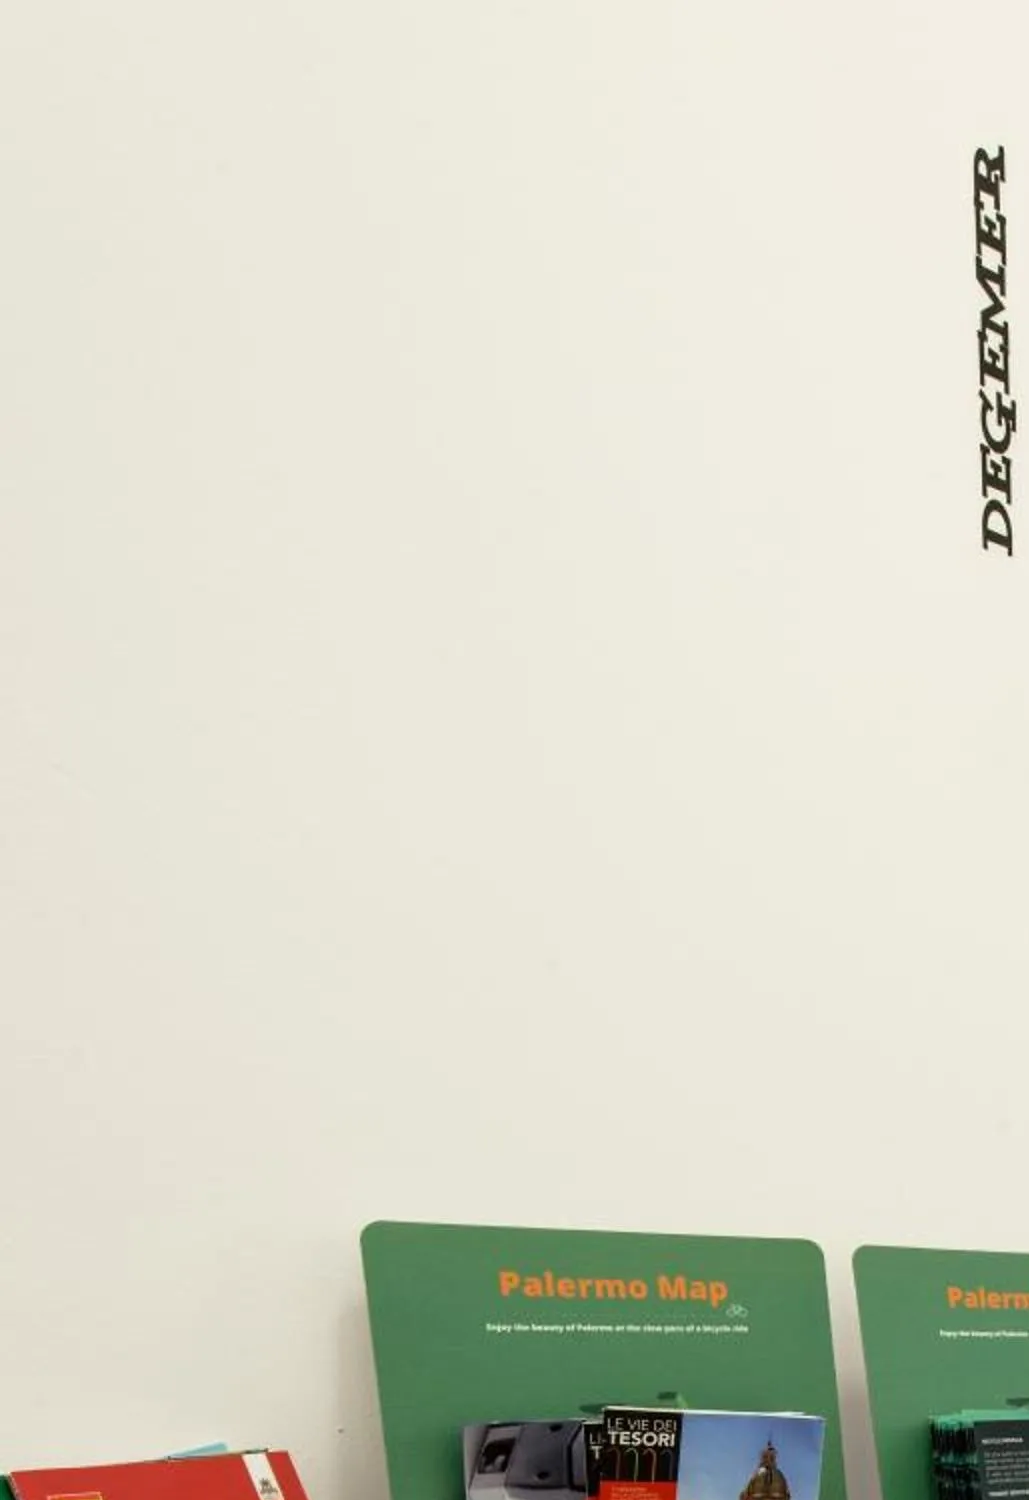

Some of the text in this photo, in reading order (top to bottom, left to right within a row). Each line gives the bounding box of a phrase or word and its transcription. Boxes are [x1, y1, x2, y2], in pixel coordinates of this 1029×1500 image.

[973, 145, 1017, 557] DEGEMER
[498, 1269, 729, 1309] Palermo Map
[607, 1418, 677, 1433] LE VIE DEI
[608, 1431, 675, 1447] TESORI
